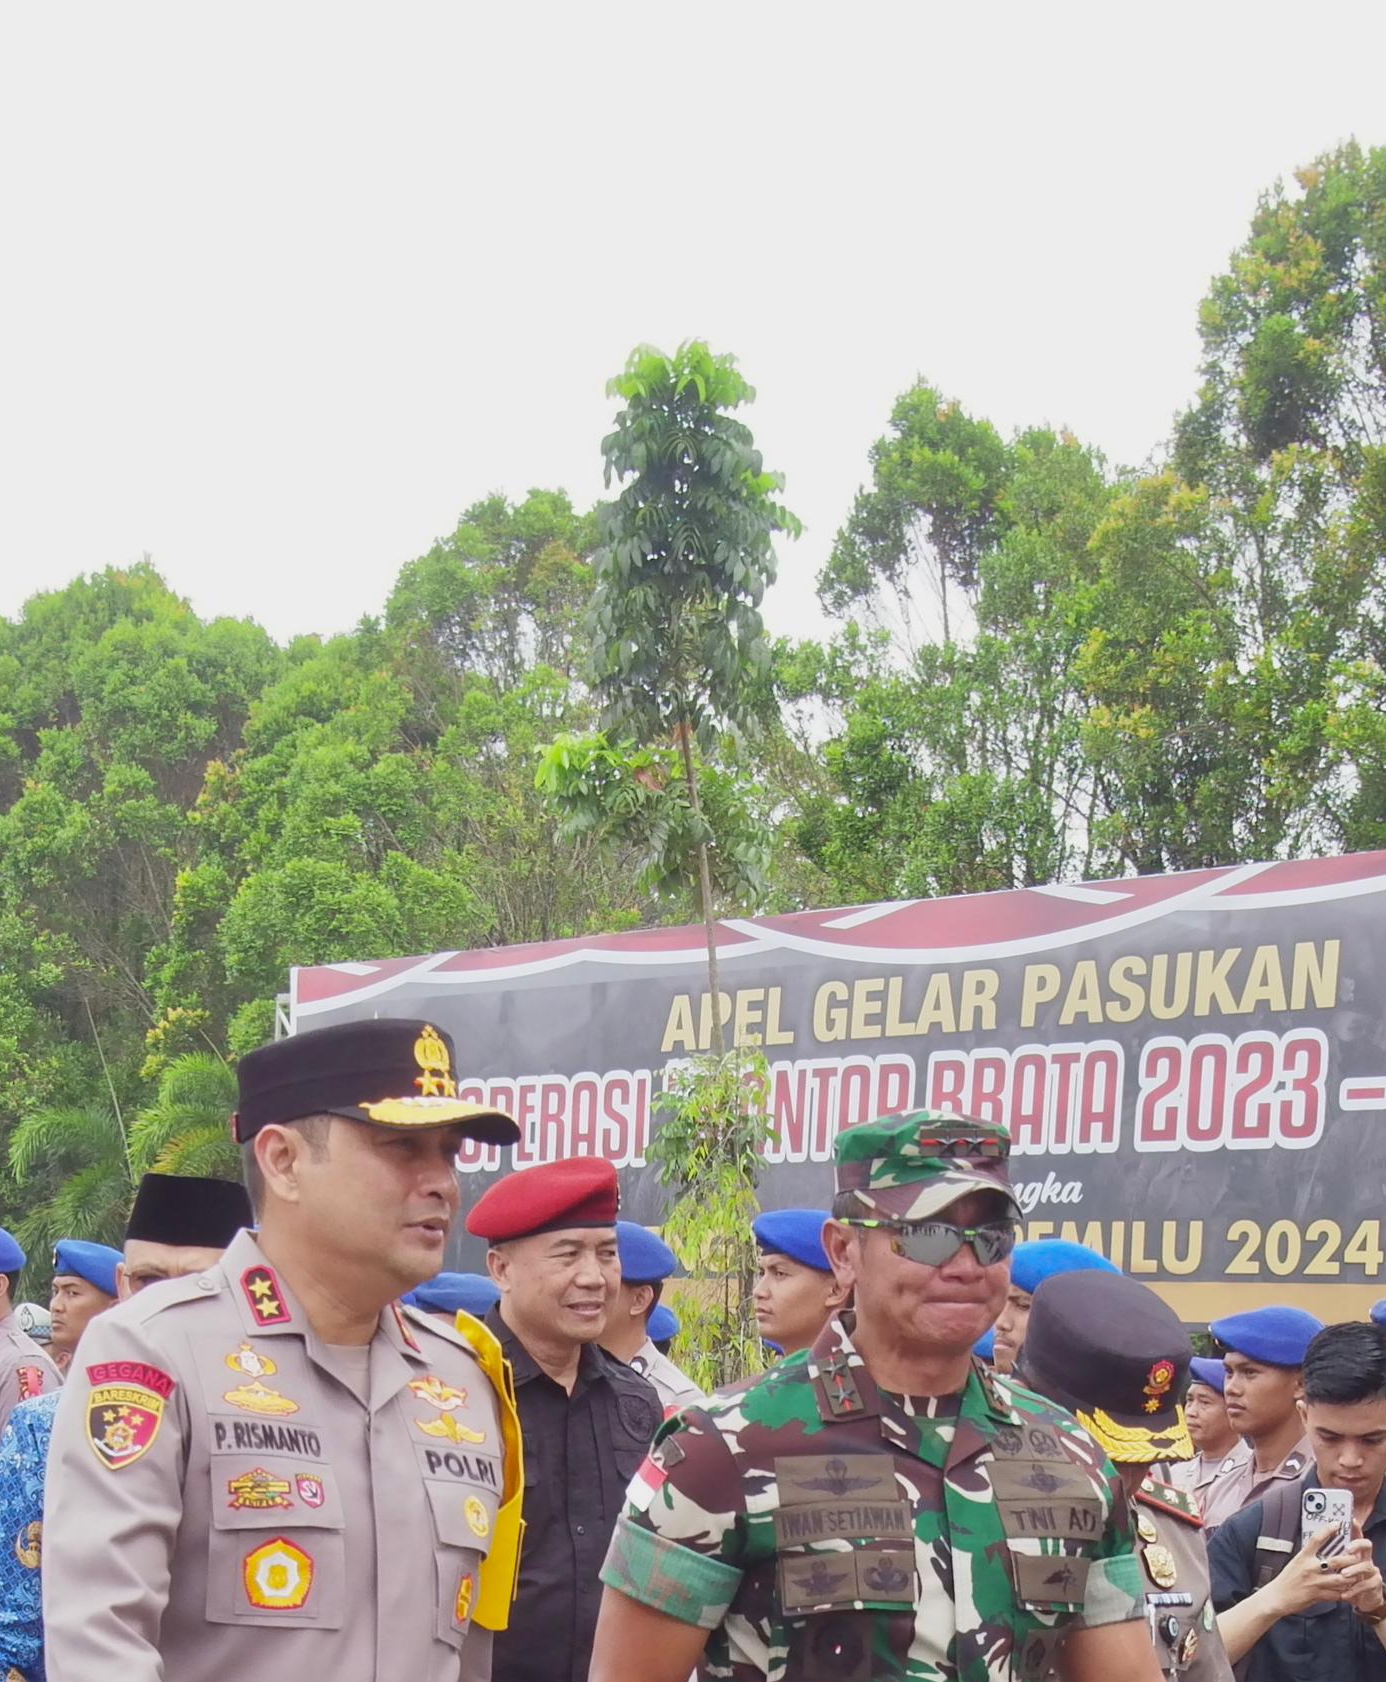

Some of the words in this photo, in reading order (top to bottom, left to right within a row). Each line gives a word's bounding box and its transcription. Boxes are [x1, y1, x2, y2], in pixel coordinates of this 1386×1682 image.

[661, 987, 794, 1052] APEL
[813, 969, 1000, 1043] GELAR
[1020, 940, 1341, 1028] PASUKAN
[928, 1041, 1122, 1155] BRATA
[1135, 1028, 1328, 1151] 2023
[1013, 1172, 1084, 1213] ngka
[1224, 1219, 1384, 1276] 2024
[93, 1363, 170, 1398] GEGANA
[94, 1390, 161, 1412] BARESKRIM
[233, 1421, 322, 1458] RISMANTO
[424, 1449, 497, 1487] POLRI
[781, 1506, 823, 1539] IWAN
[828, 1505, 905, 1533] SETIAWAN
[1009, 1508, 1057, 1531] TNI
[1068, 1508, 1098, 1533] AD
